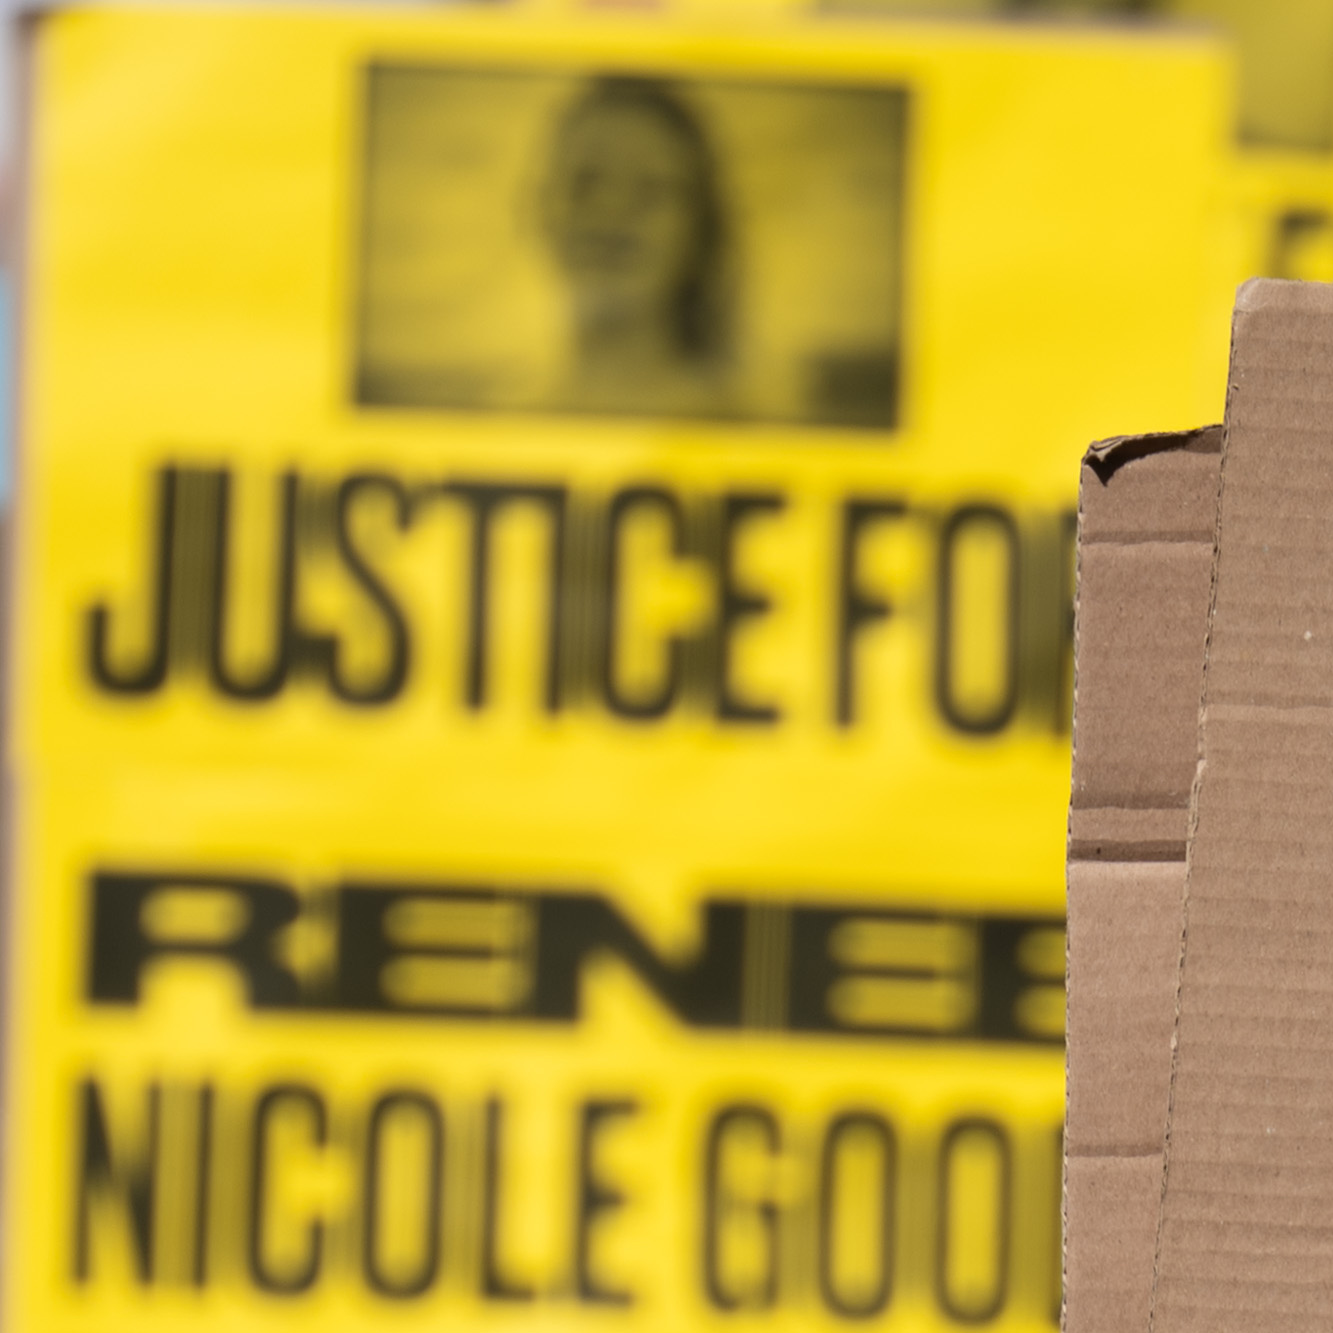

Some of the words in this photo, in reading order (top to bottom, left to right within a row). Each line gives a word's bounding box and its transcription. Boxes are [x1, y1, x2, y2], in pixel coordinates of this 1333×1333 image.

[86, 462, 790, 728] JUSTICE
[833, 495, 1076, 740] FO
[72, 1078, 642, 1308] NICOLE
[702, 1102, 1066, 1330] GOO
